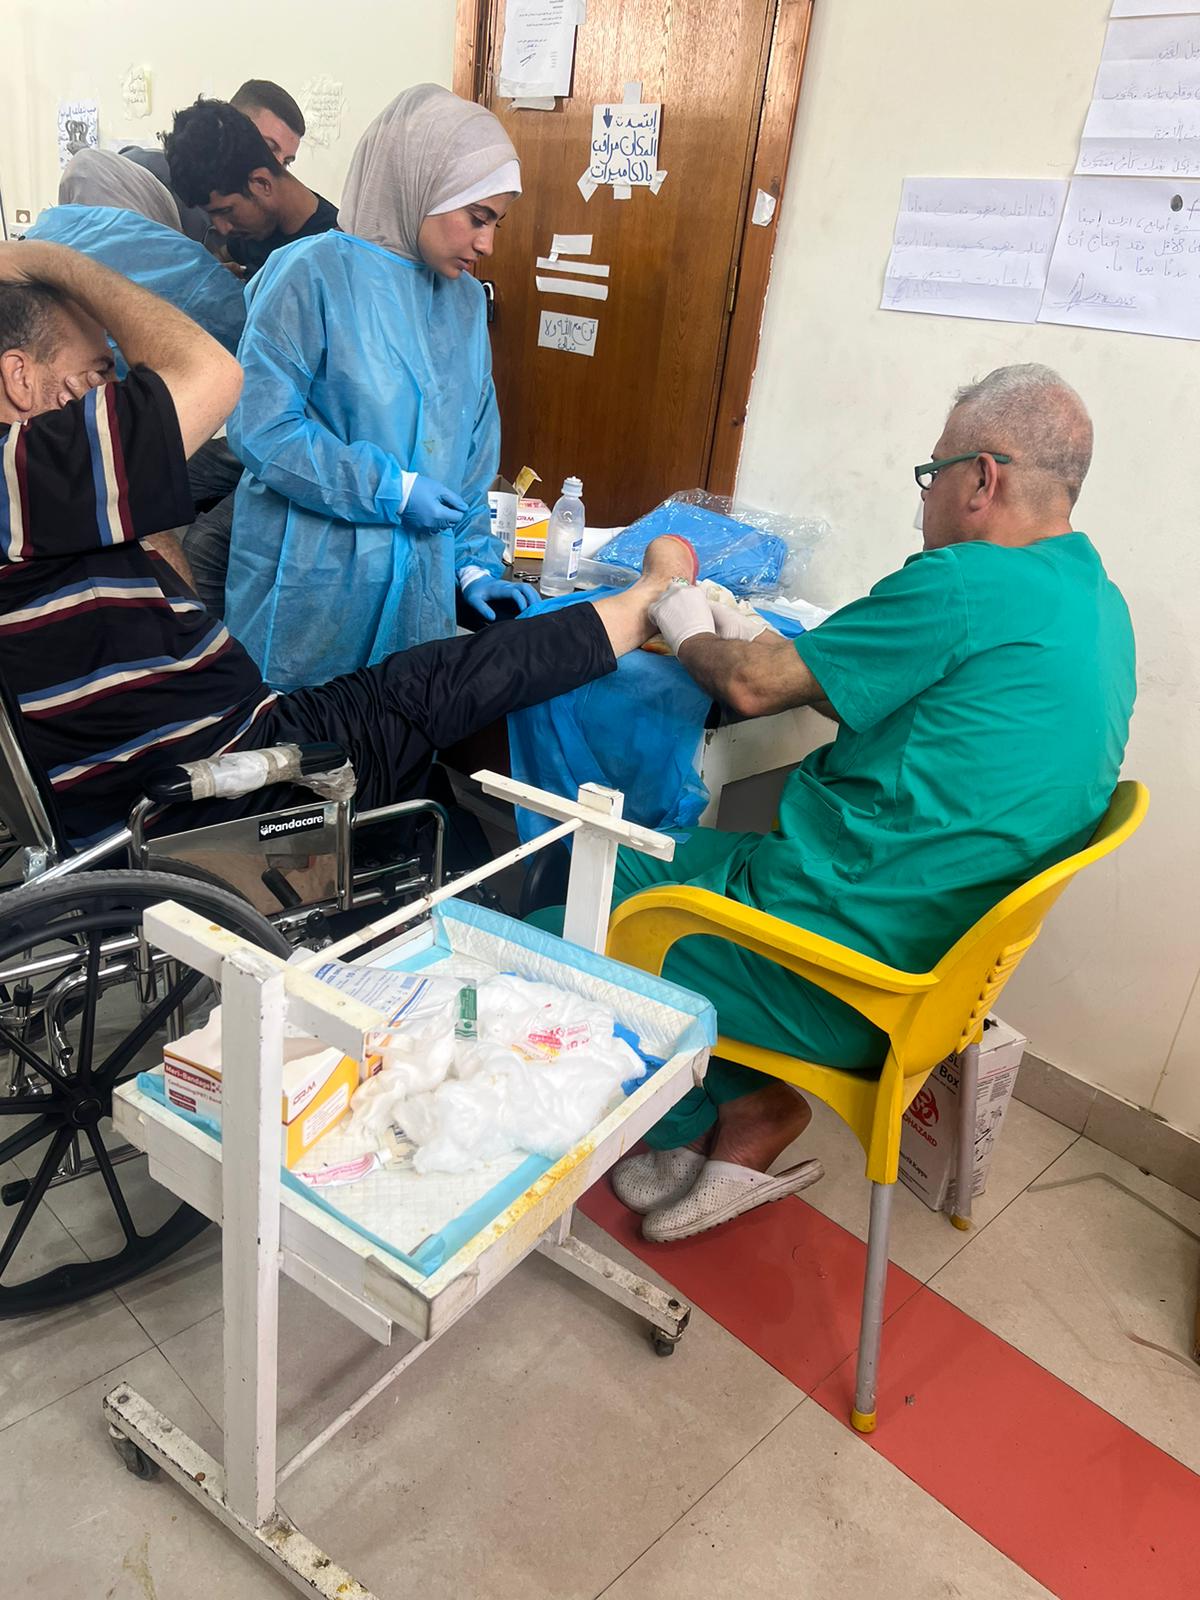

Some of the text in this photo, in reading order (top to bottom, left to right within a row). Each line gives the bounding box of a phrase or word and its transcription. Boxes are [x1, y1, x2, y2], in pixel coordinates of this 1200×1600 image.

[592, 130, 657, 165] المكان مراقب
[590, 158, 653, 185] بالكاميرات
[268, 814, 324, 834] Pandacare
[939, 1064, 960, 1089] Box
[902, 1113, 938, 1147] OHAZARD
